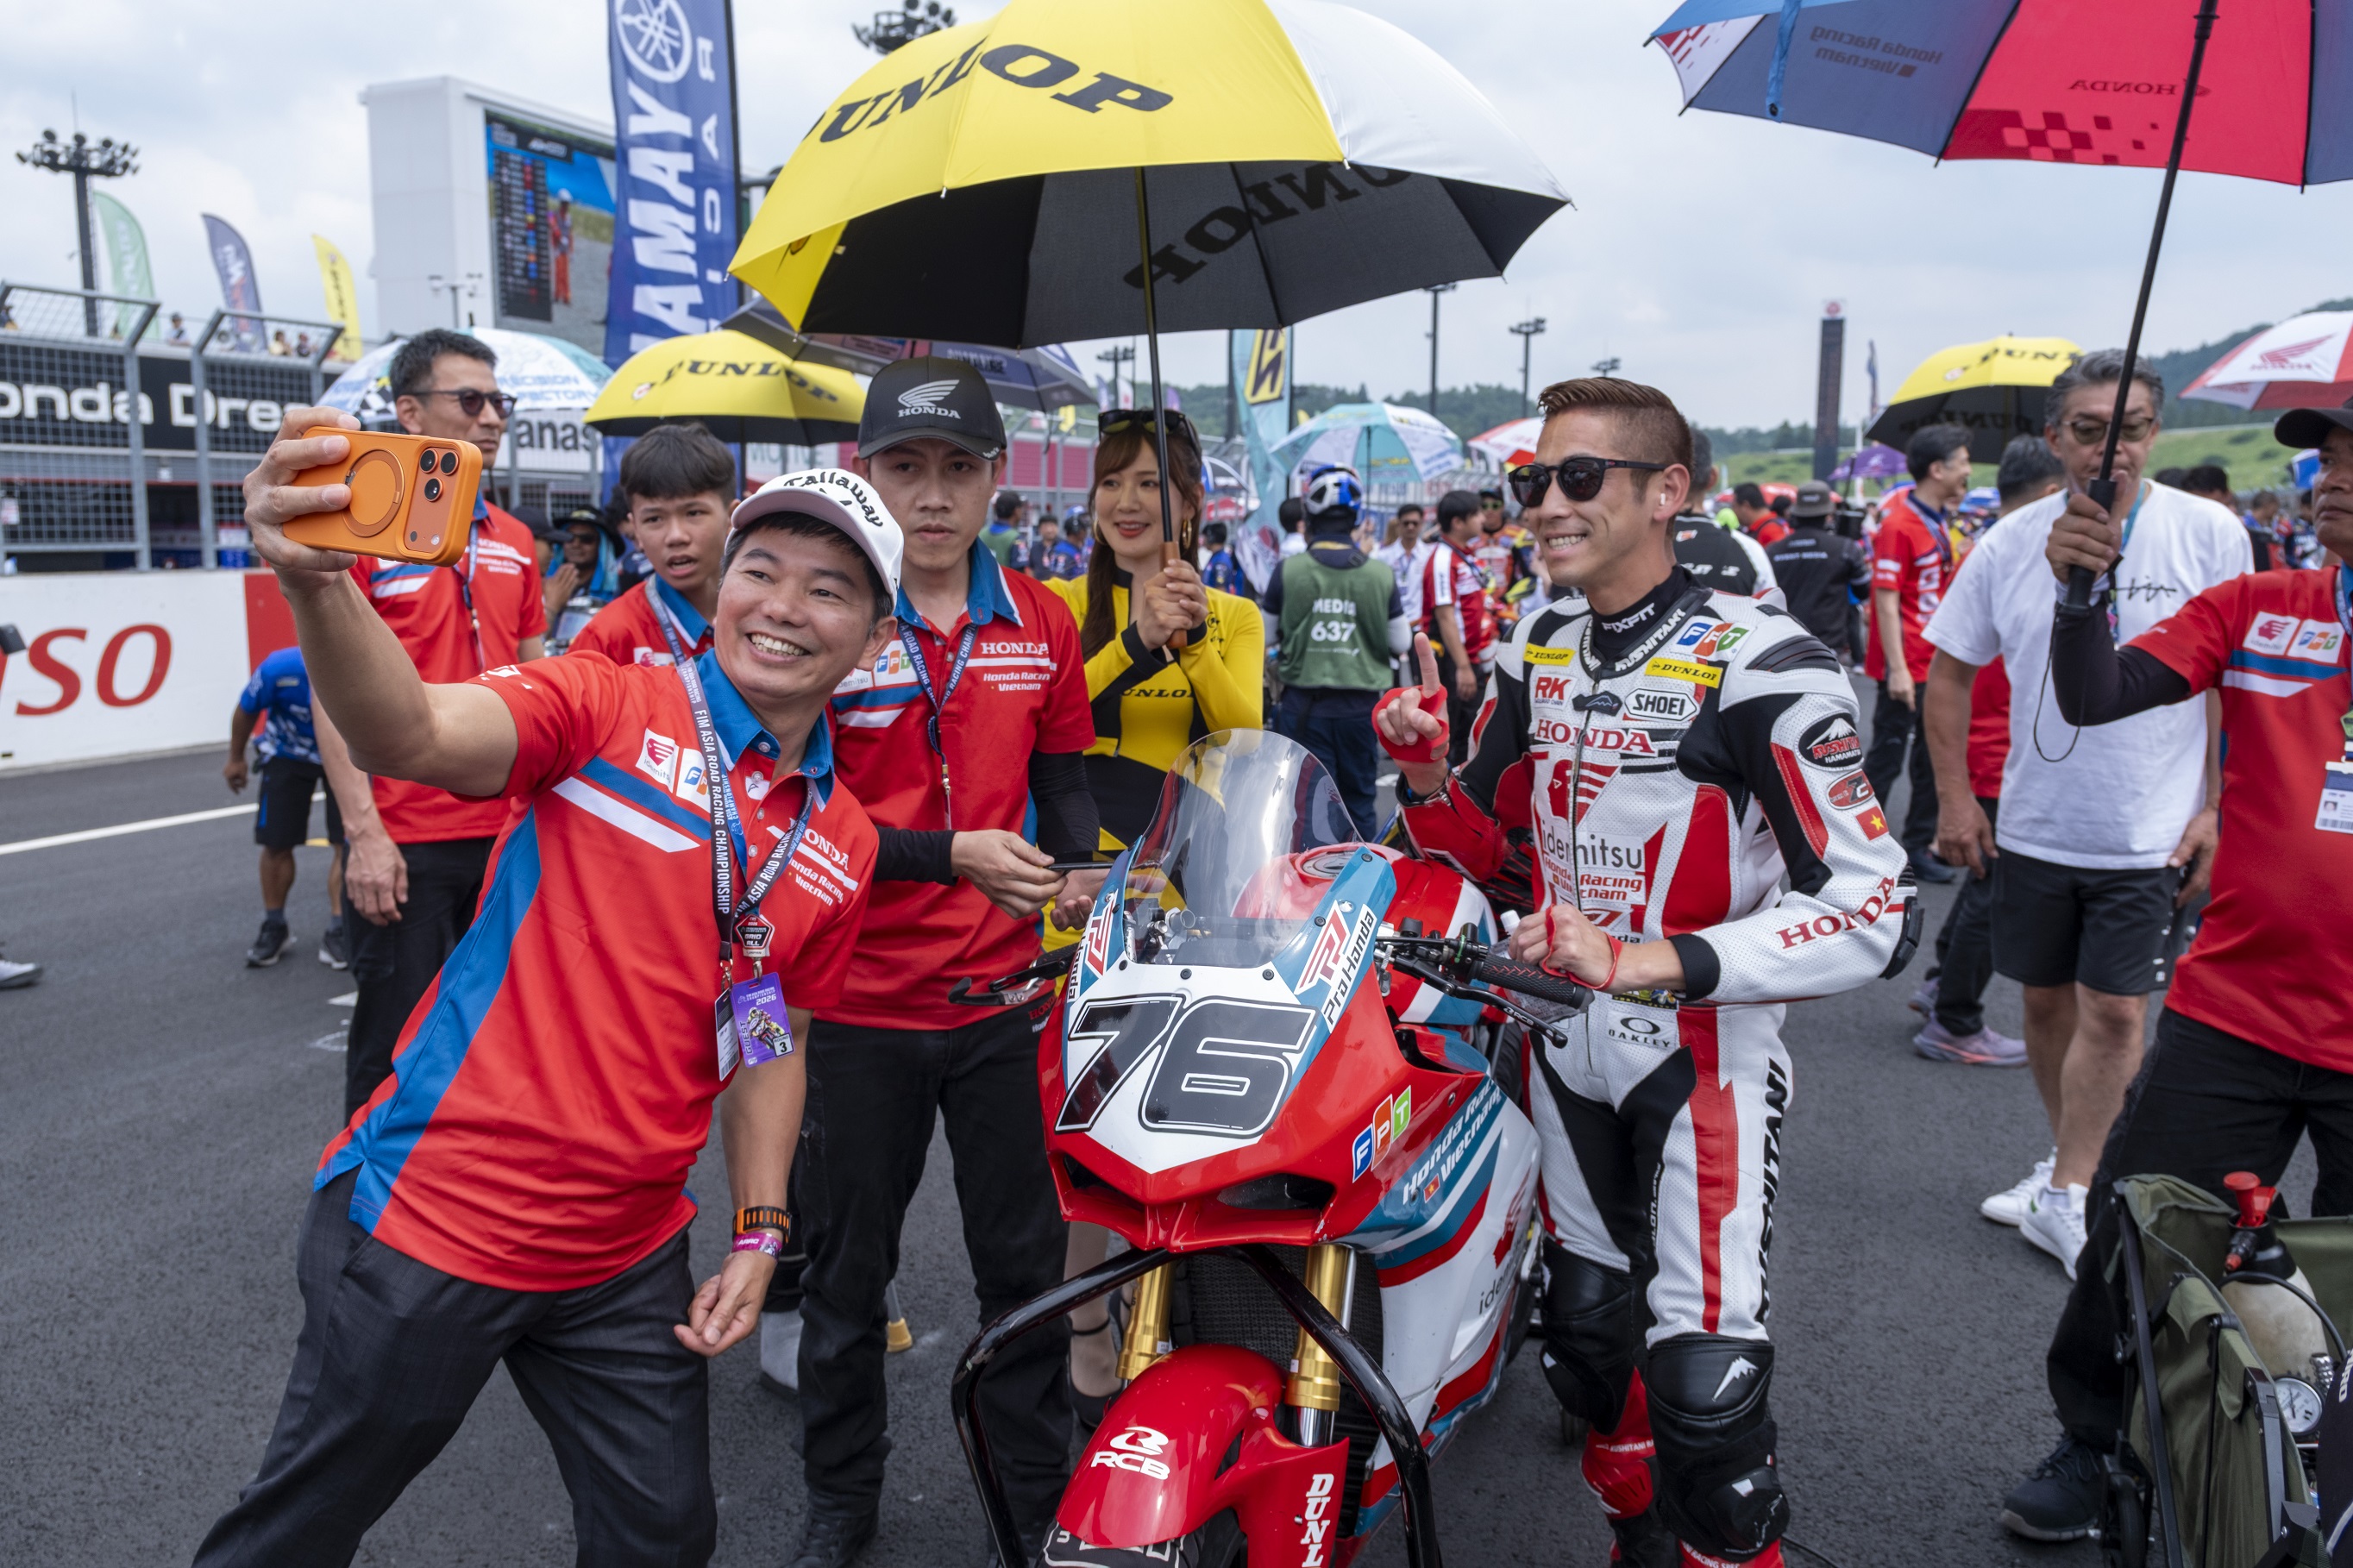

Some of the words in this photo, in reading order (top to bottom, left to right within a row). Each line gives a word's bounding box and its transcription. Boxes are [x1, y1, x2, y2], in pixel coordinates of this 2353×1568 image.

[804, 35, 1174, 142] UNLOP
[496, 373, 580, 387] RECISION
[0, 382, 154, 424] onda
[170, 382, 309, 431] Dre
[898, 406, 961, 419] HONDA
[783, 471, 883, 527] Callaway
[1312, 598, 1356, 616] MEDIA
[1311, 620, 1356, 643] 637
[1615, 608, 1686, 672] KUSHITANI
[2300, 632, 2338, 649] FPT
[904, 631, 919, 654] ROAD
[913, 653, 931, 685] RACING
[981, 642, 1049, 655] HONDA
[878, 654, 911, 672] FPT
[950, 660, 965, 690] RACING
[983, 672, 1020, 681] Honda
[1020, 672, 1051, 681] Racin
[838, 676, 869, 688] demitsu
[998, 683, 1042, 692] Vietnam
[1121, 688, 1195, 699] UNLO
[1535, 677, 1572, 700] RK
[1633, 693, 1686, 716] SHOEI
[694, 709, 710, 728] FIM
[700, 731, 716, 752] ASIA
[1536, 718, 1656, 754] HONDA
[1812, 735, 1861, 759] KUSHITA
[707, 755, 721, 781] ROAD
[712, 785, 725, 825] RACING
[796, 820, 850, 871] ONDA
[1542, 819, 1642, 869] idemitsu
[715, 830, 731, 914] CHAMPIONSHIP
[748, 881, 769, 904] ASIA
[761, 859, 781, 882] ROAD
[1579, 874, 1643, 893] Racing
[795, 873, 834, 906] Vietnam
[818, 875, 844, 904] Racing
[1776, 876, 1895, 950] HONDA
[756, 994, 776, 1006] 2026
[1513, 1011, 1534, 1026] RCB
[740, 1021, 754, 1054] GUEST
[779, 1041, 787, 1053] 3
[1609, 1029, 1671, 1048] OAKLEY
[1055, 993, 1319, 1138] 76
[1354, 1093, 1409, 1175] FPT
[1440, 1085, 1502, 1182] Vietnam
[1402, 1115, 1464, 1205] Honda
[1091, 1451, 1170, 1480] RCB
[1300, 1473, 1334, 1568] DUNL
